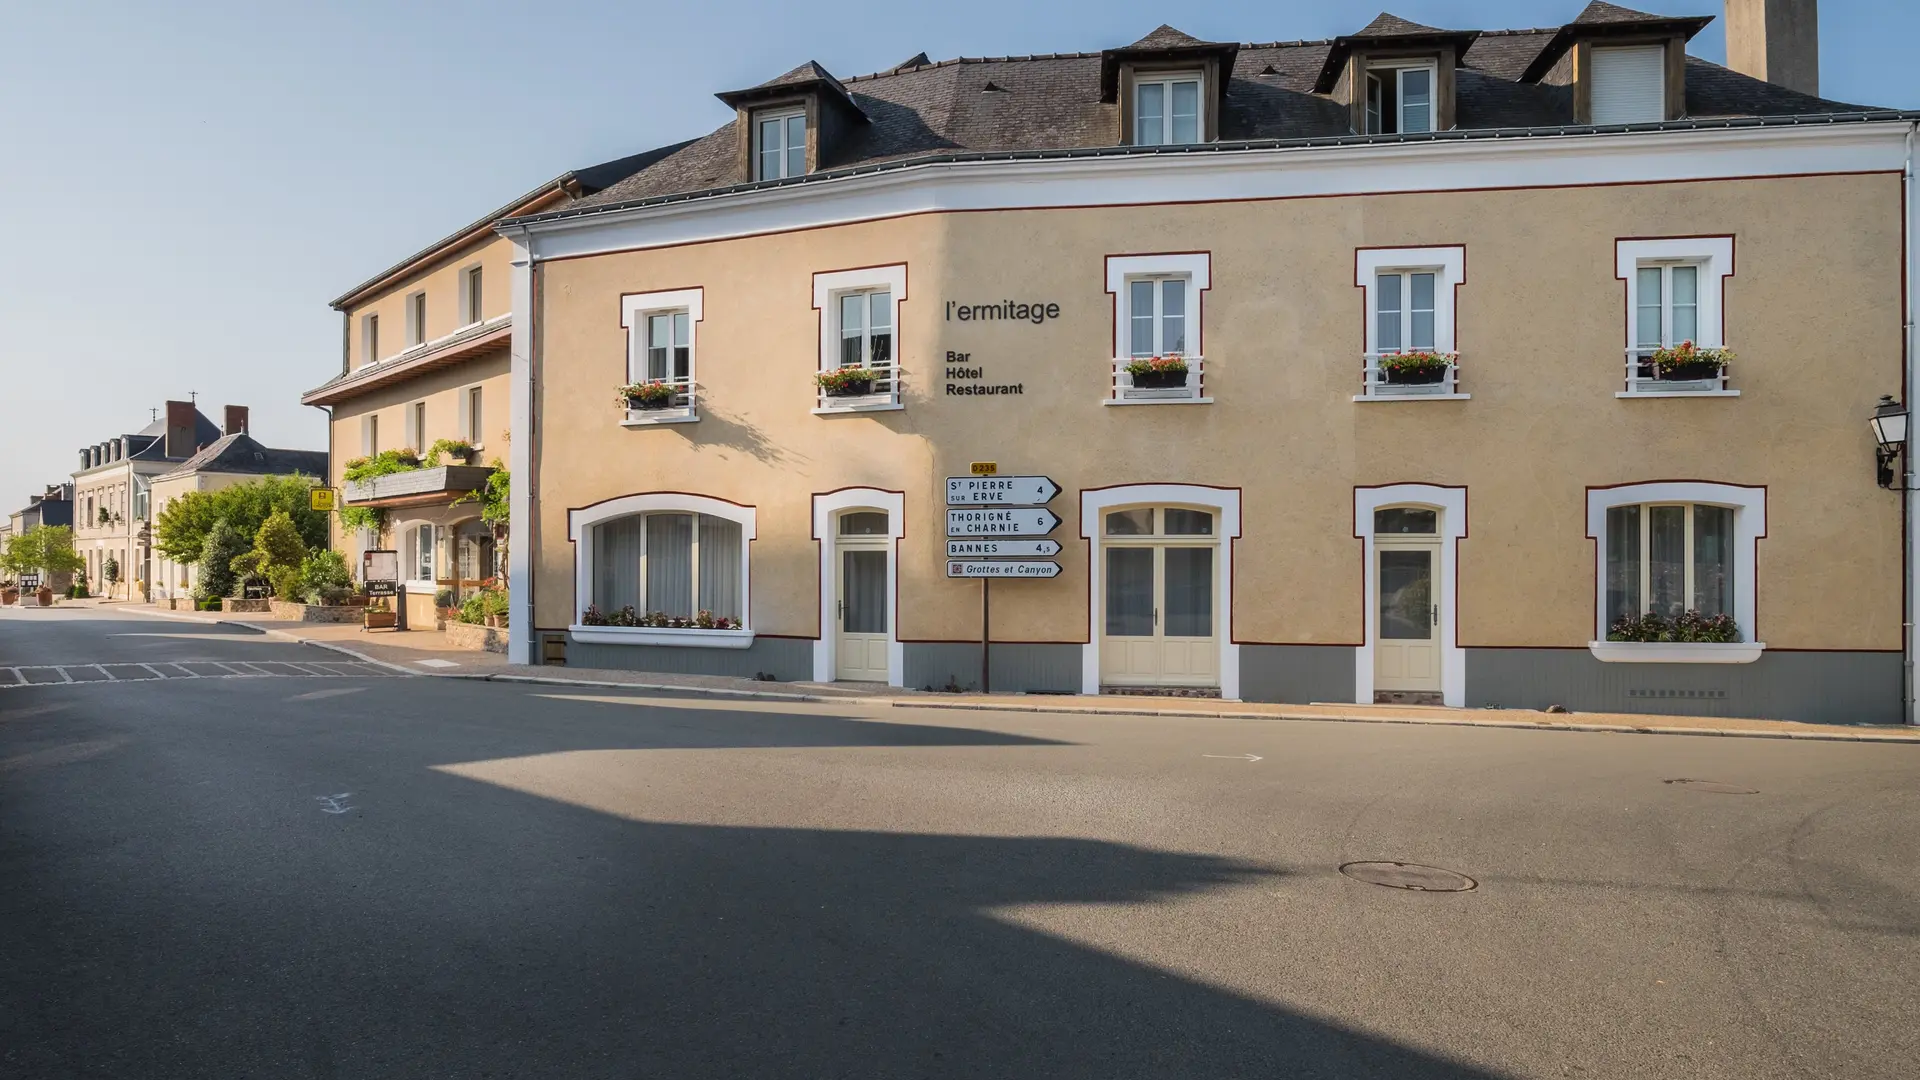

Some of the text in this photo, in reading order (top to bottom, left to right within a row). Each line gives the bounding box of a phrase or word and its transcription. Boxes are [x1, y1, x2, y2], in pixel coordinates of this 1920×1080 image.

[946, 299, 1060, 324] l'ermitage
[946, 351, 971, 363] Bar
[946, 366, 982, 379] Hôtel
[946, 383, 1023, 396] Restaurant
[969, 481, 1013, 490] PIERRE
[1037, 486, 1043, 494] 4
[973, 492, 1003, 500] ERVE
[951, 511, 1043, 526] THORIGNÉ 6
[967, 523, 1019, 532] CHARNIE
[951, 544, 998, 553] BANNES
[966, 564, 1052, 575] Grottes et Canyon
